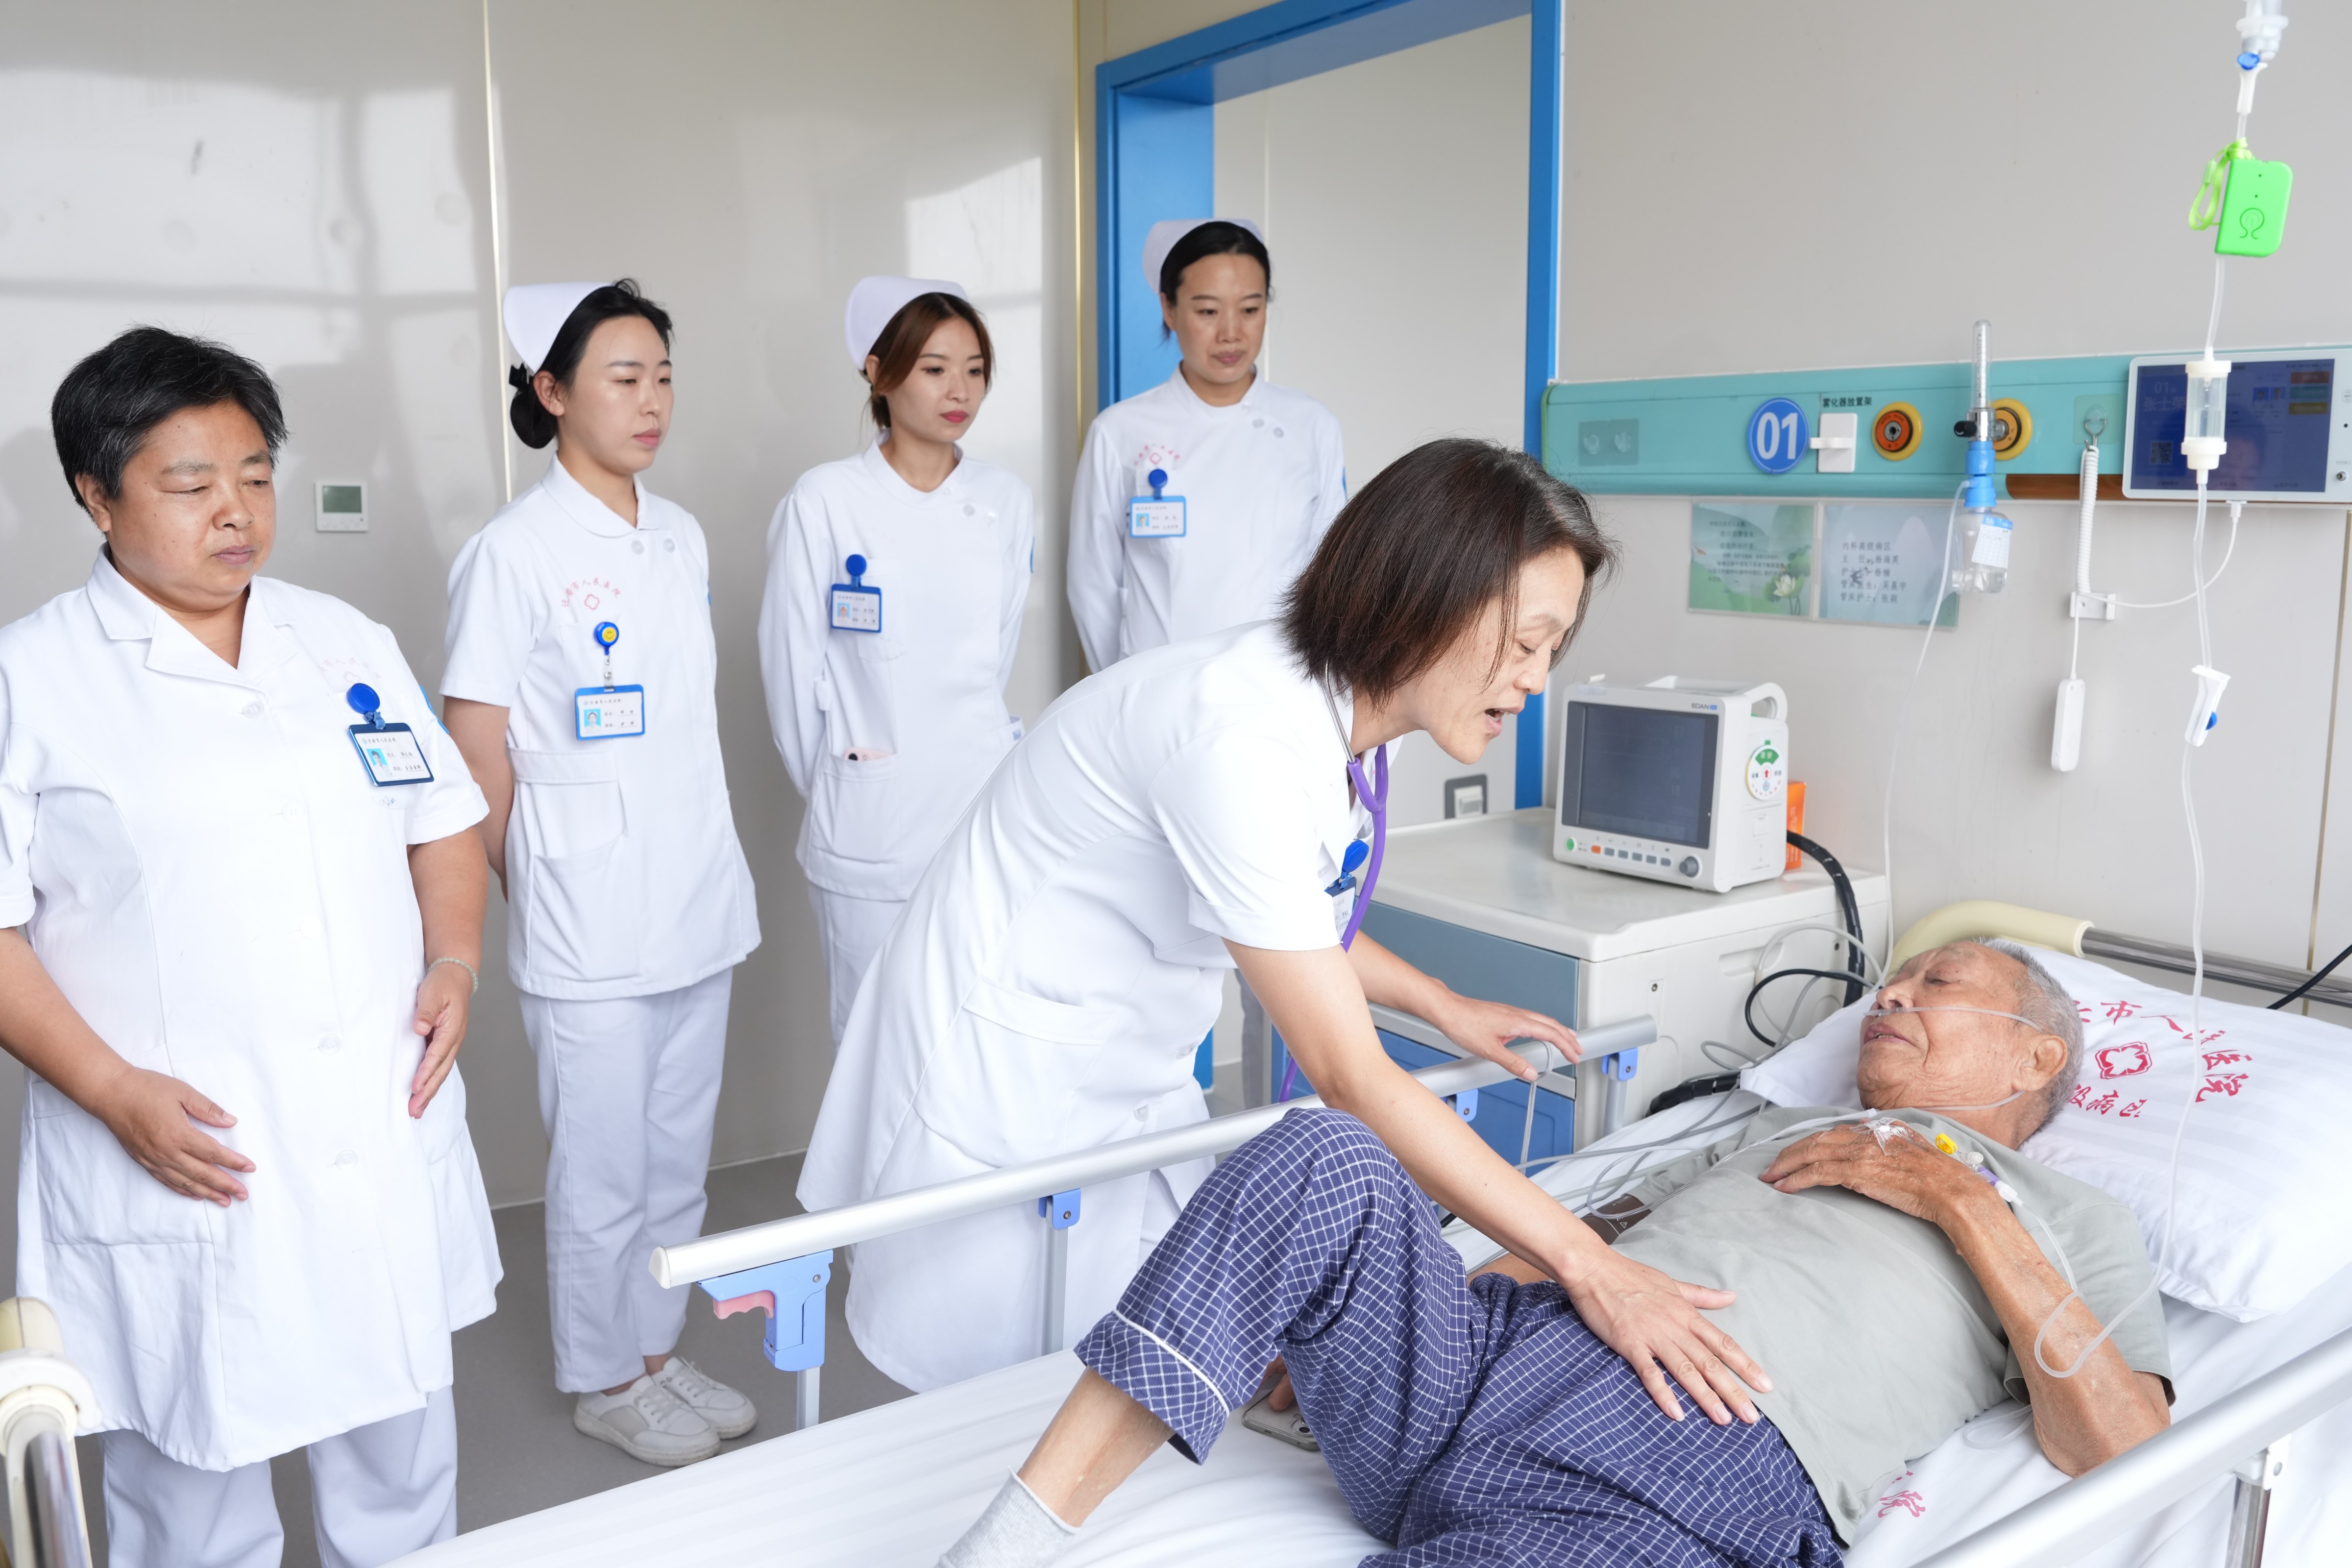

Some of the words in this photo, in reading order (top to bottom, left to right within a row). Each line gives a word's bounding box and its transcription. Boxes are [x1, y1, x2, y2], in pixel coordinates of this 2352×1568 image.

[1822, 396, 1872, 408] 雾化器放置架
[1757, 412, 1798, 460] 01
